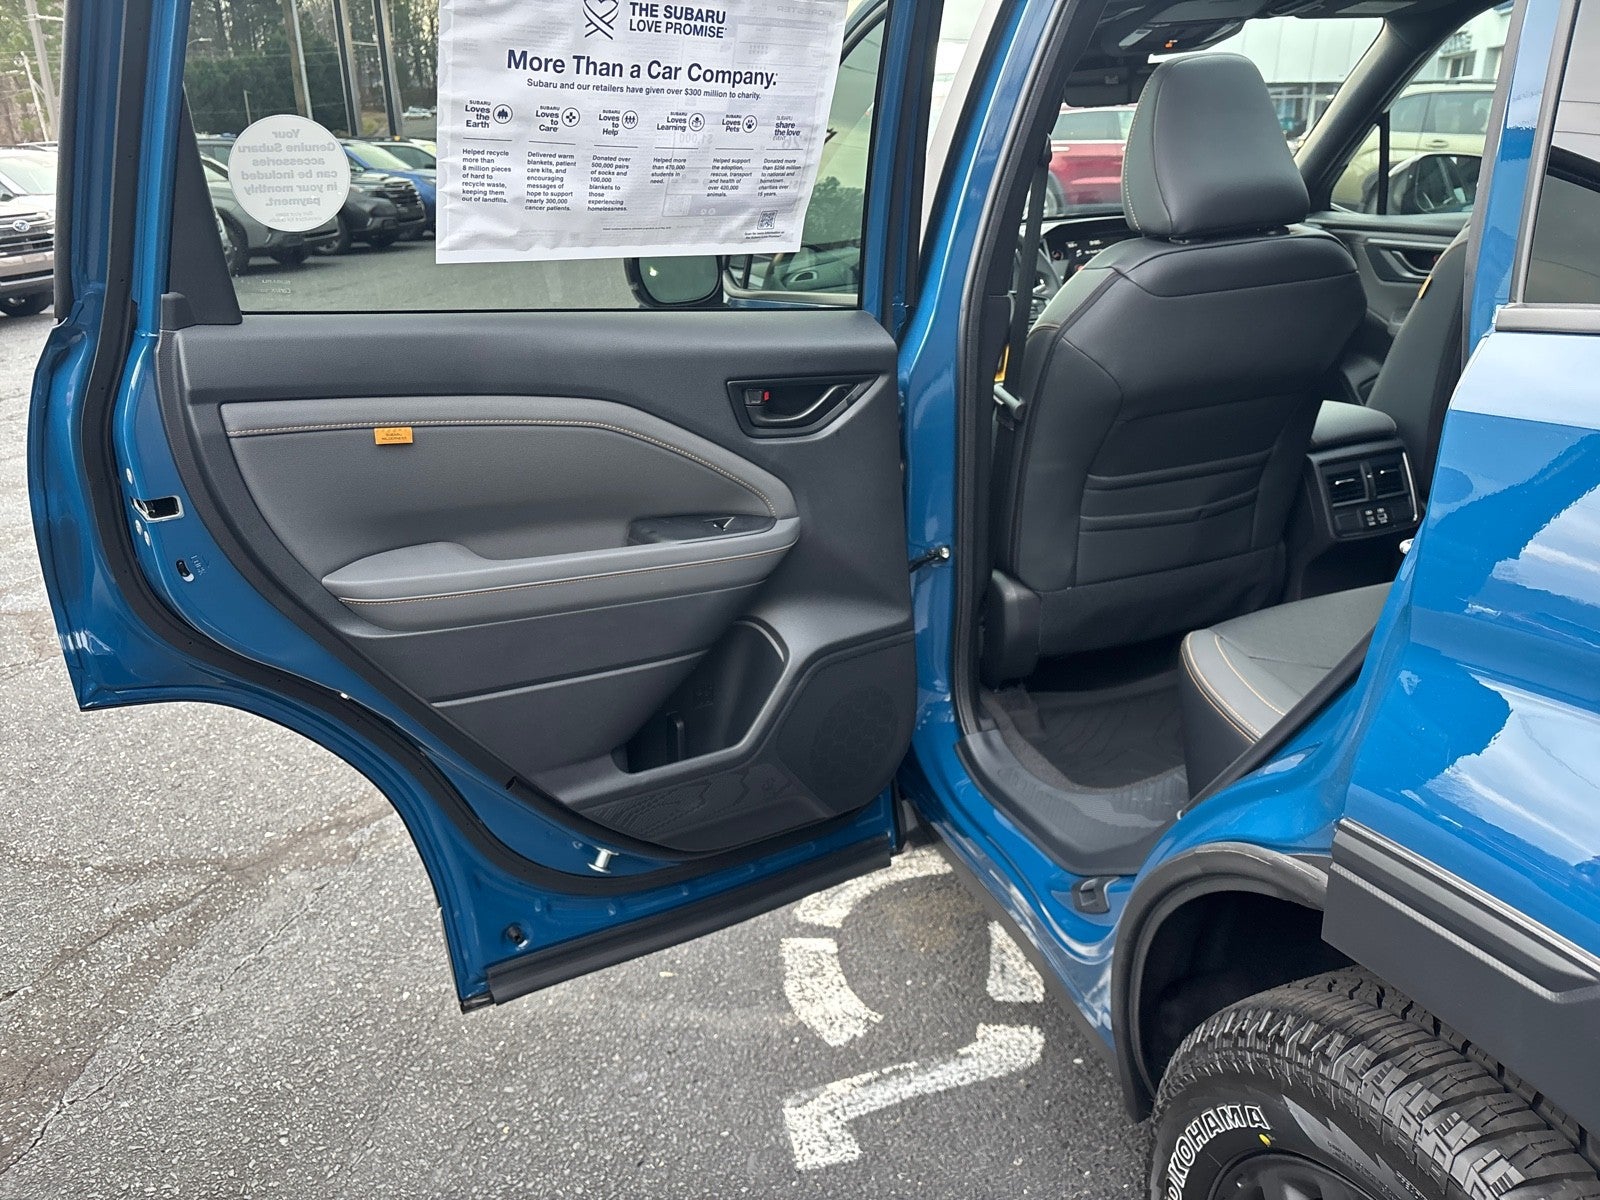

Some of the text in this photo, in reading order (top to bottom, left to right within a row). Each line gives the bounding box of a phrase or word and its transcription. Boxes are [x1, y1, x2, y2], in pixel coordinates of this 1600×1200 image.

[630, 2, 726, 24] THE SUBARU
[630, 19, 724, 38] LOVE PROMISE
[507, 49, 777, 89] More Than a Car Company.
[527, 78, 557, 88] Subaru
[592, 84, 624, 92] retailers
[626, 85, 644, 93] have
[645, 87, 664, 95] given
[684, 88, 701, 96] $300
[703, 90, 727, 98] million
[738, 92, 761, 100] charity.
[465, 105, 490, 114] Loves
[535, 110, 560, 118] Loves
[466, 120, 490, 128] Earth
[539, 124, 558, 132] Care
[656, 123, 687, 132] Learning
[602, 128, 619, 136] Help
